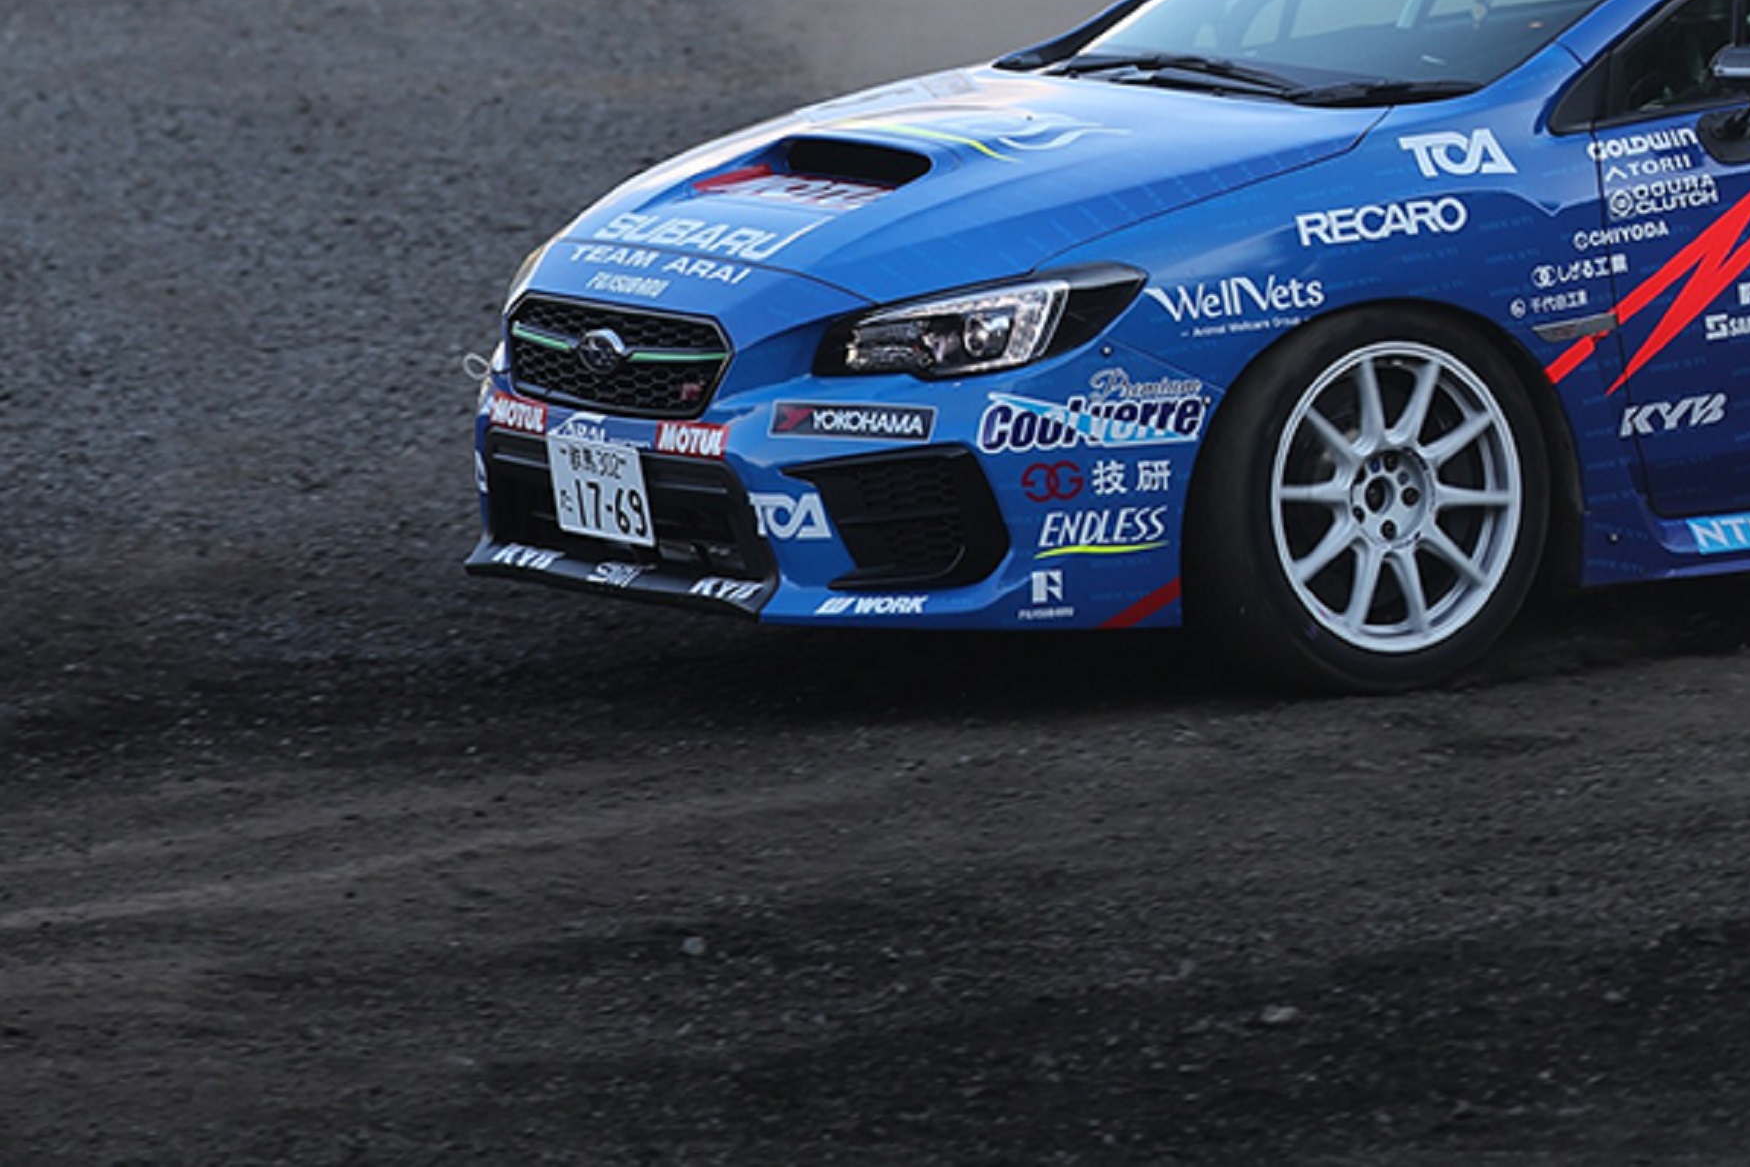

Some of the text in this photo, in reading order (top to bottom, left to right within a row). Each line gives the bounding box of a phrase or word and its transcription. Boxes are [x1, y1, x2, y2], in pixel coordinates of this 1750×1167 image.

[1586, 127, 1698, 161] GOLDWIN
[1296, 196, 1467, 247] RECARO
[1635, 188, 1719, 215] CLUTCH
[594, 211, 835, 260] SUBARU
[569, 243, 752, 285] TEAM ARAI
[1144, 274, 1325, 322] WellVets
[490, 394, 546, 434] MOTUL
[812, 410, 924, 436] YOKOHAMA
[1619, 392, 1728, 439] KYB
[658, 423, 724, 456] MOTUL
[1091, 458, 1171, 495] 技研
[574, 478, 649, 537] 17-69
[1038, 505, 1168, 547] ENDLESS
[854, 595, 929, 615] WORK
